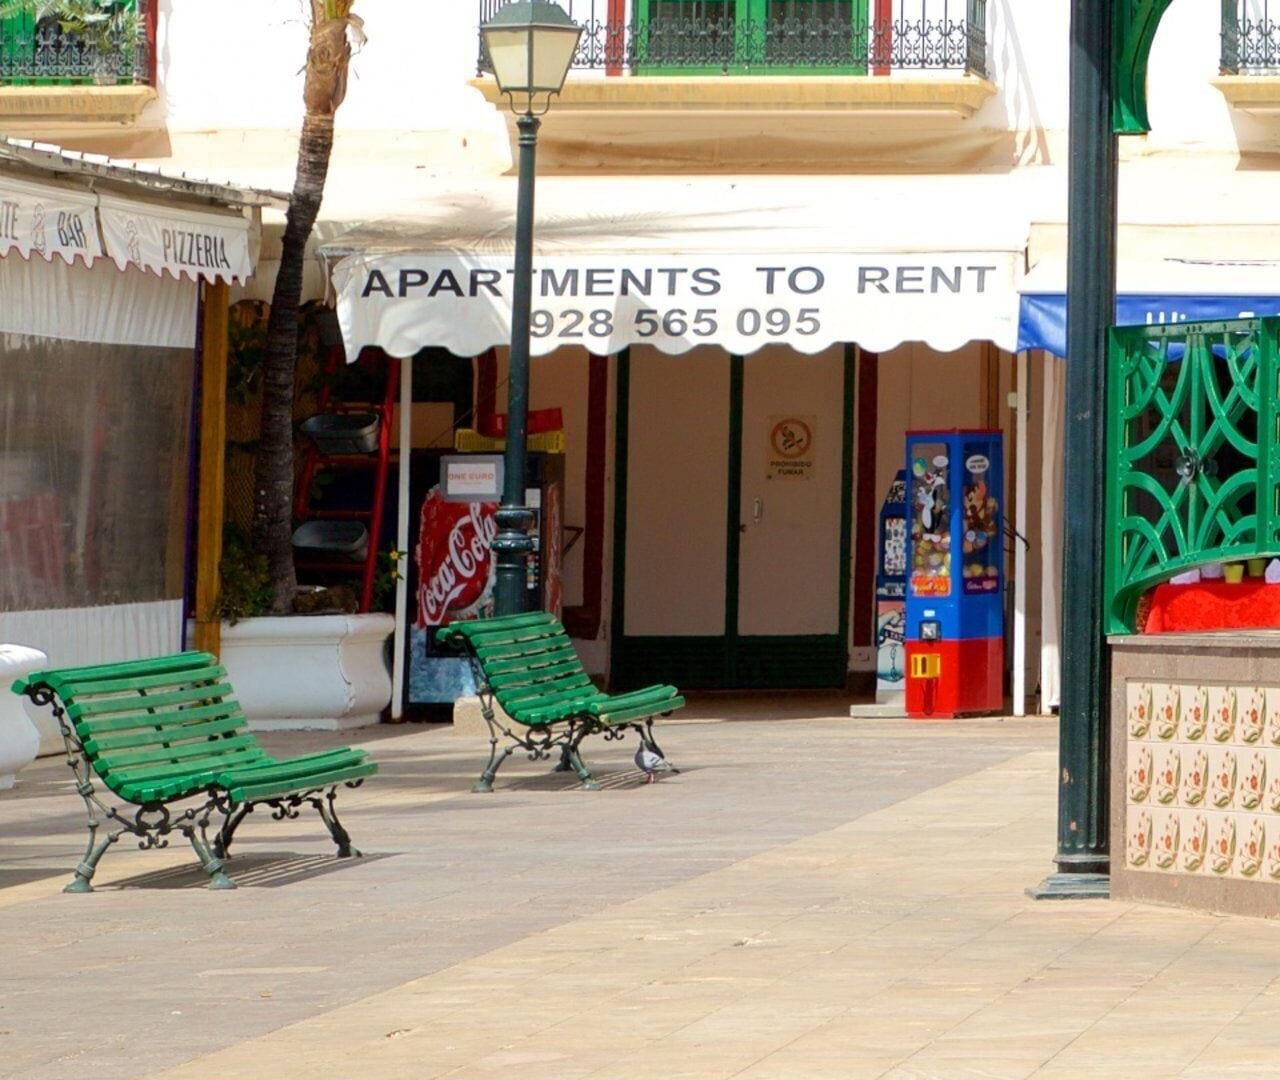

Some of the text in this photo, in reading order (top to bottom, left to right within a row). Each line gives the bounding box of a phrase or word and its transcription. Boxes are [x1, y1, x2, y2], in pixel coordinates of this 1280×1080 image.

[57, 211, 88, 249] BAR
[162, 228, 231, 270] PIZZERIA
[755, 266, 825, 295] TO
[856, 266, 997, 294] RENT
[529, 307, 821, 339] 928 565 095
